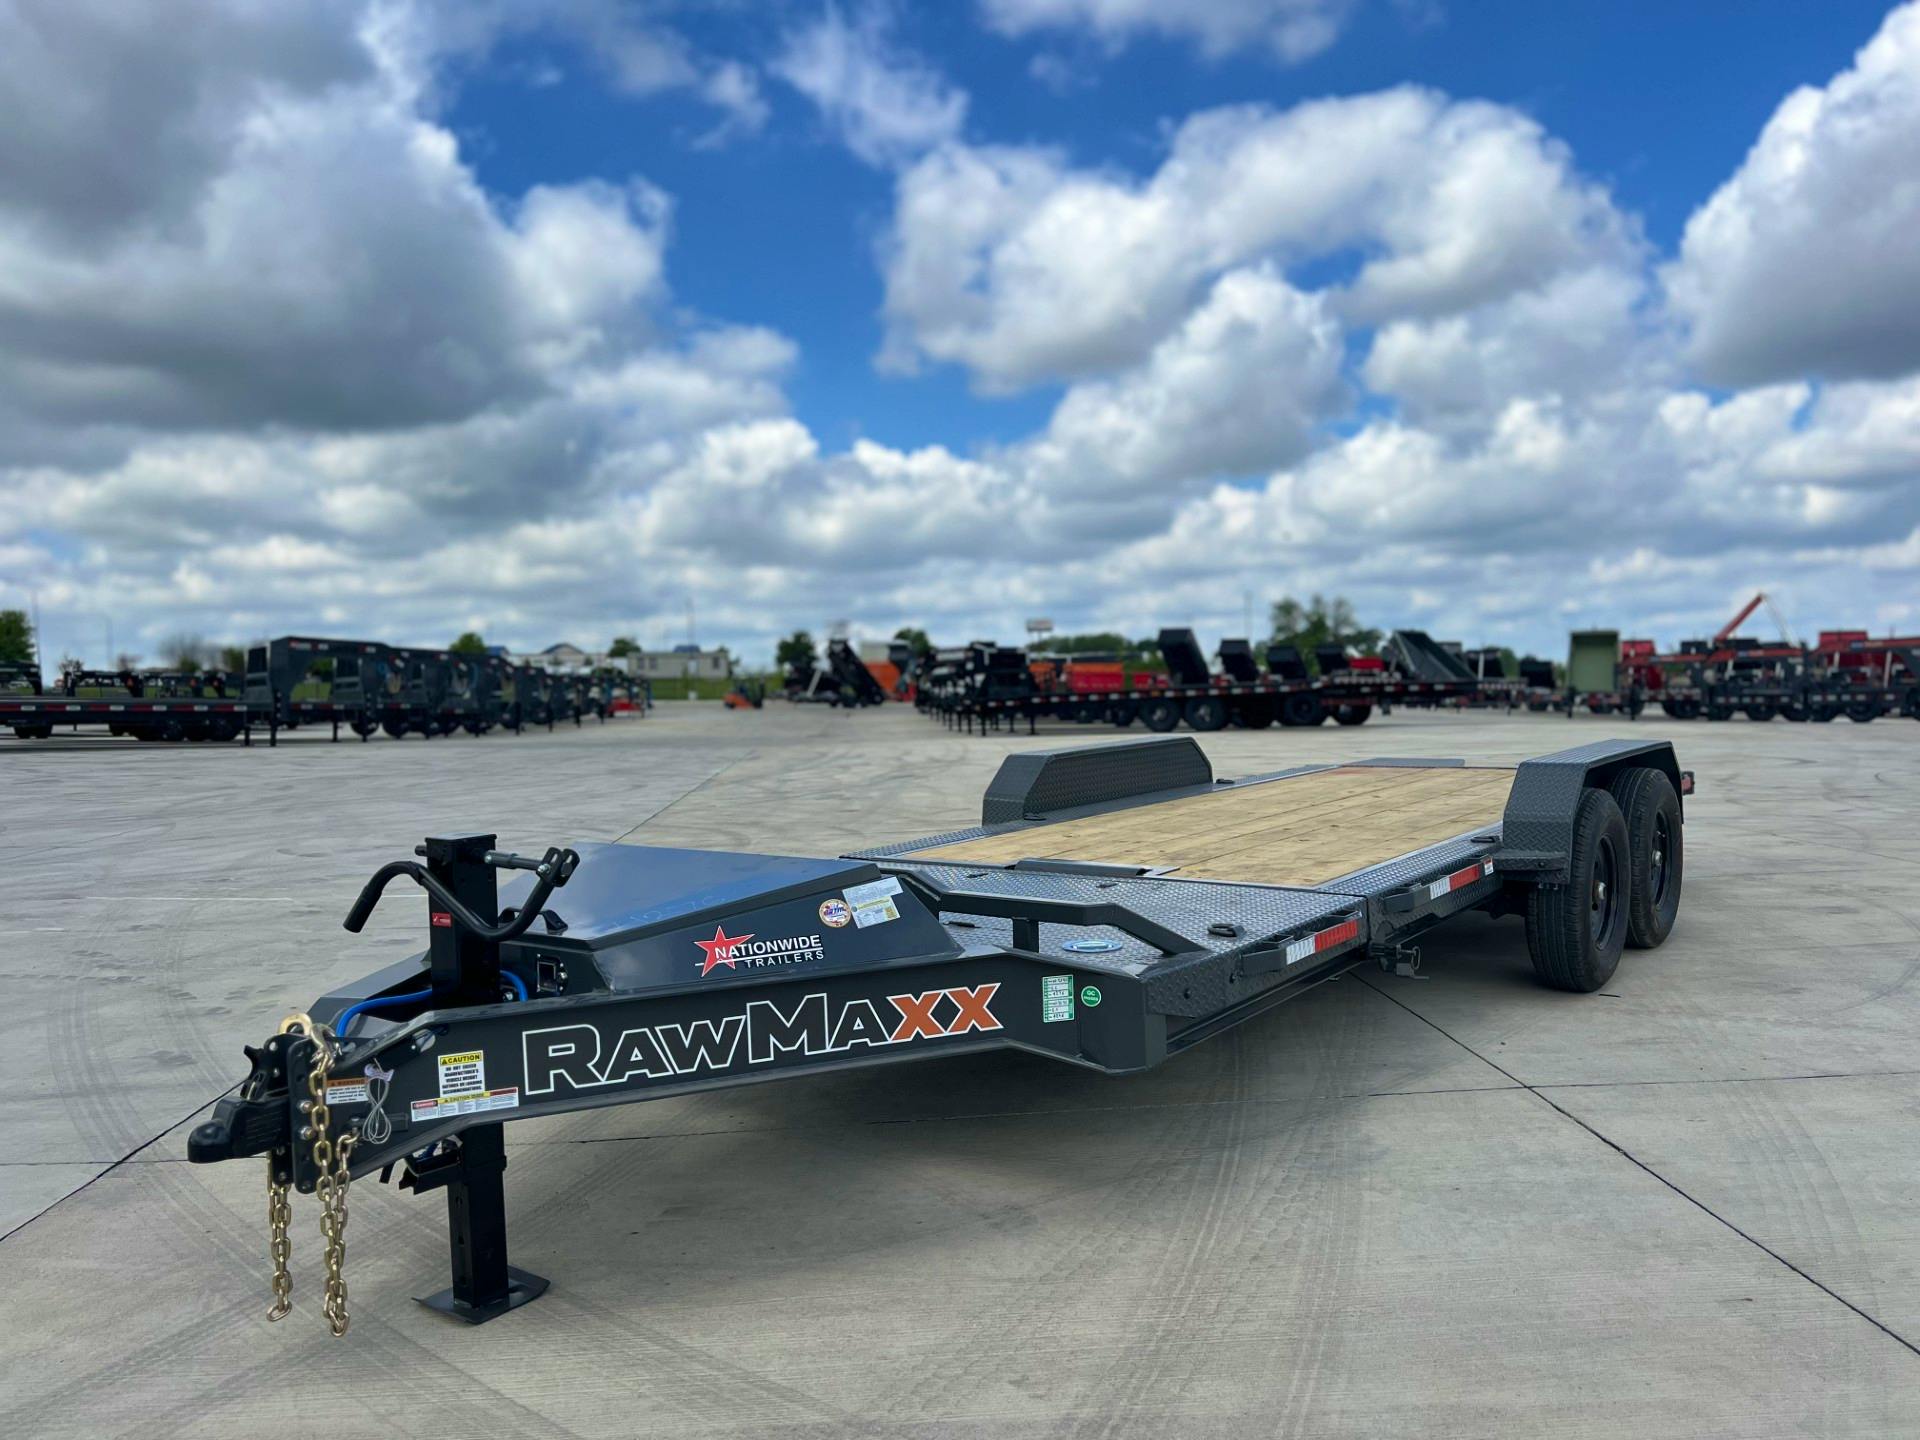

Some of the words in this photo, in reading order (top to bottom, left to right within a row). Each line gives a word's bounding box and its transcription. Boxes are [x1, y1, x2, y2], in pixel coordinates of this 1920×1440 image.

[714, 934, 822, 959] NATIONWIDE
[744, 950, 824, 969] TRAILERS
[522, 982, 1003, 1095] RAWMAXX
[447, 1054, 480, 1064] CAUTION
